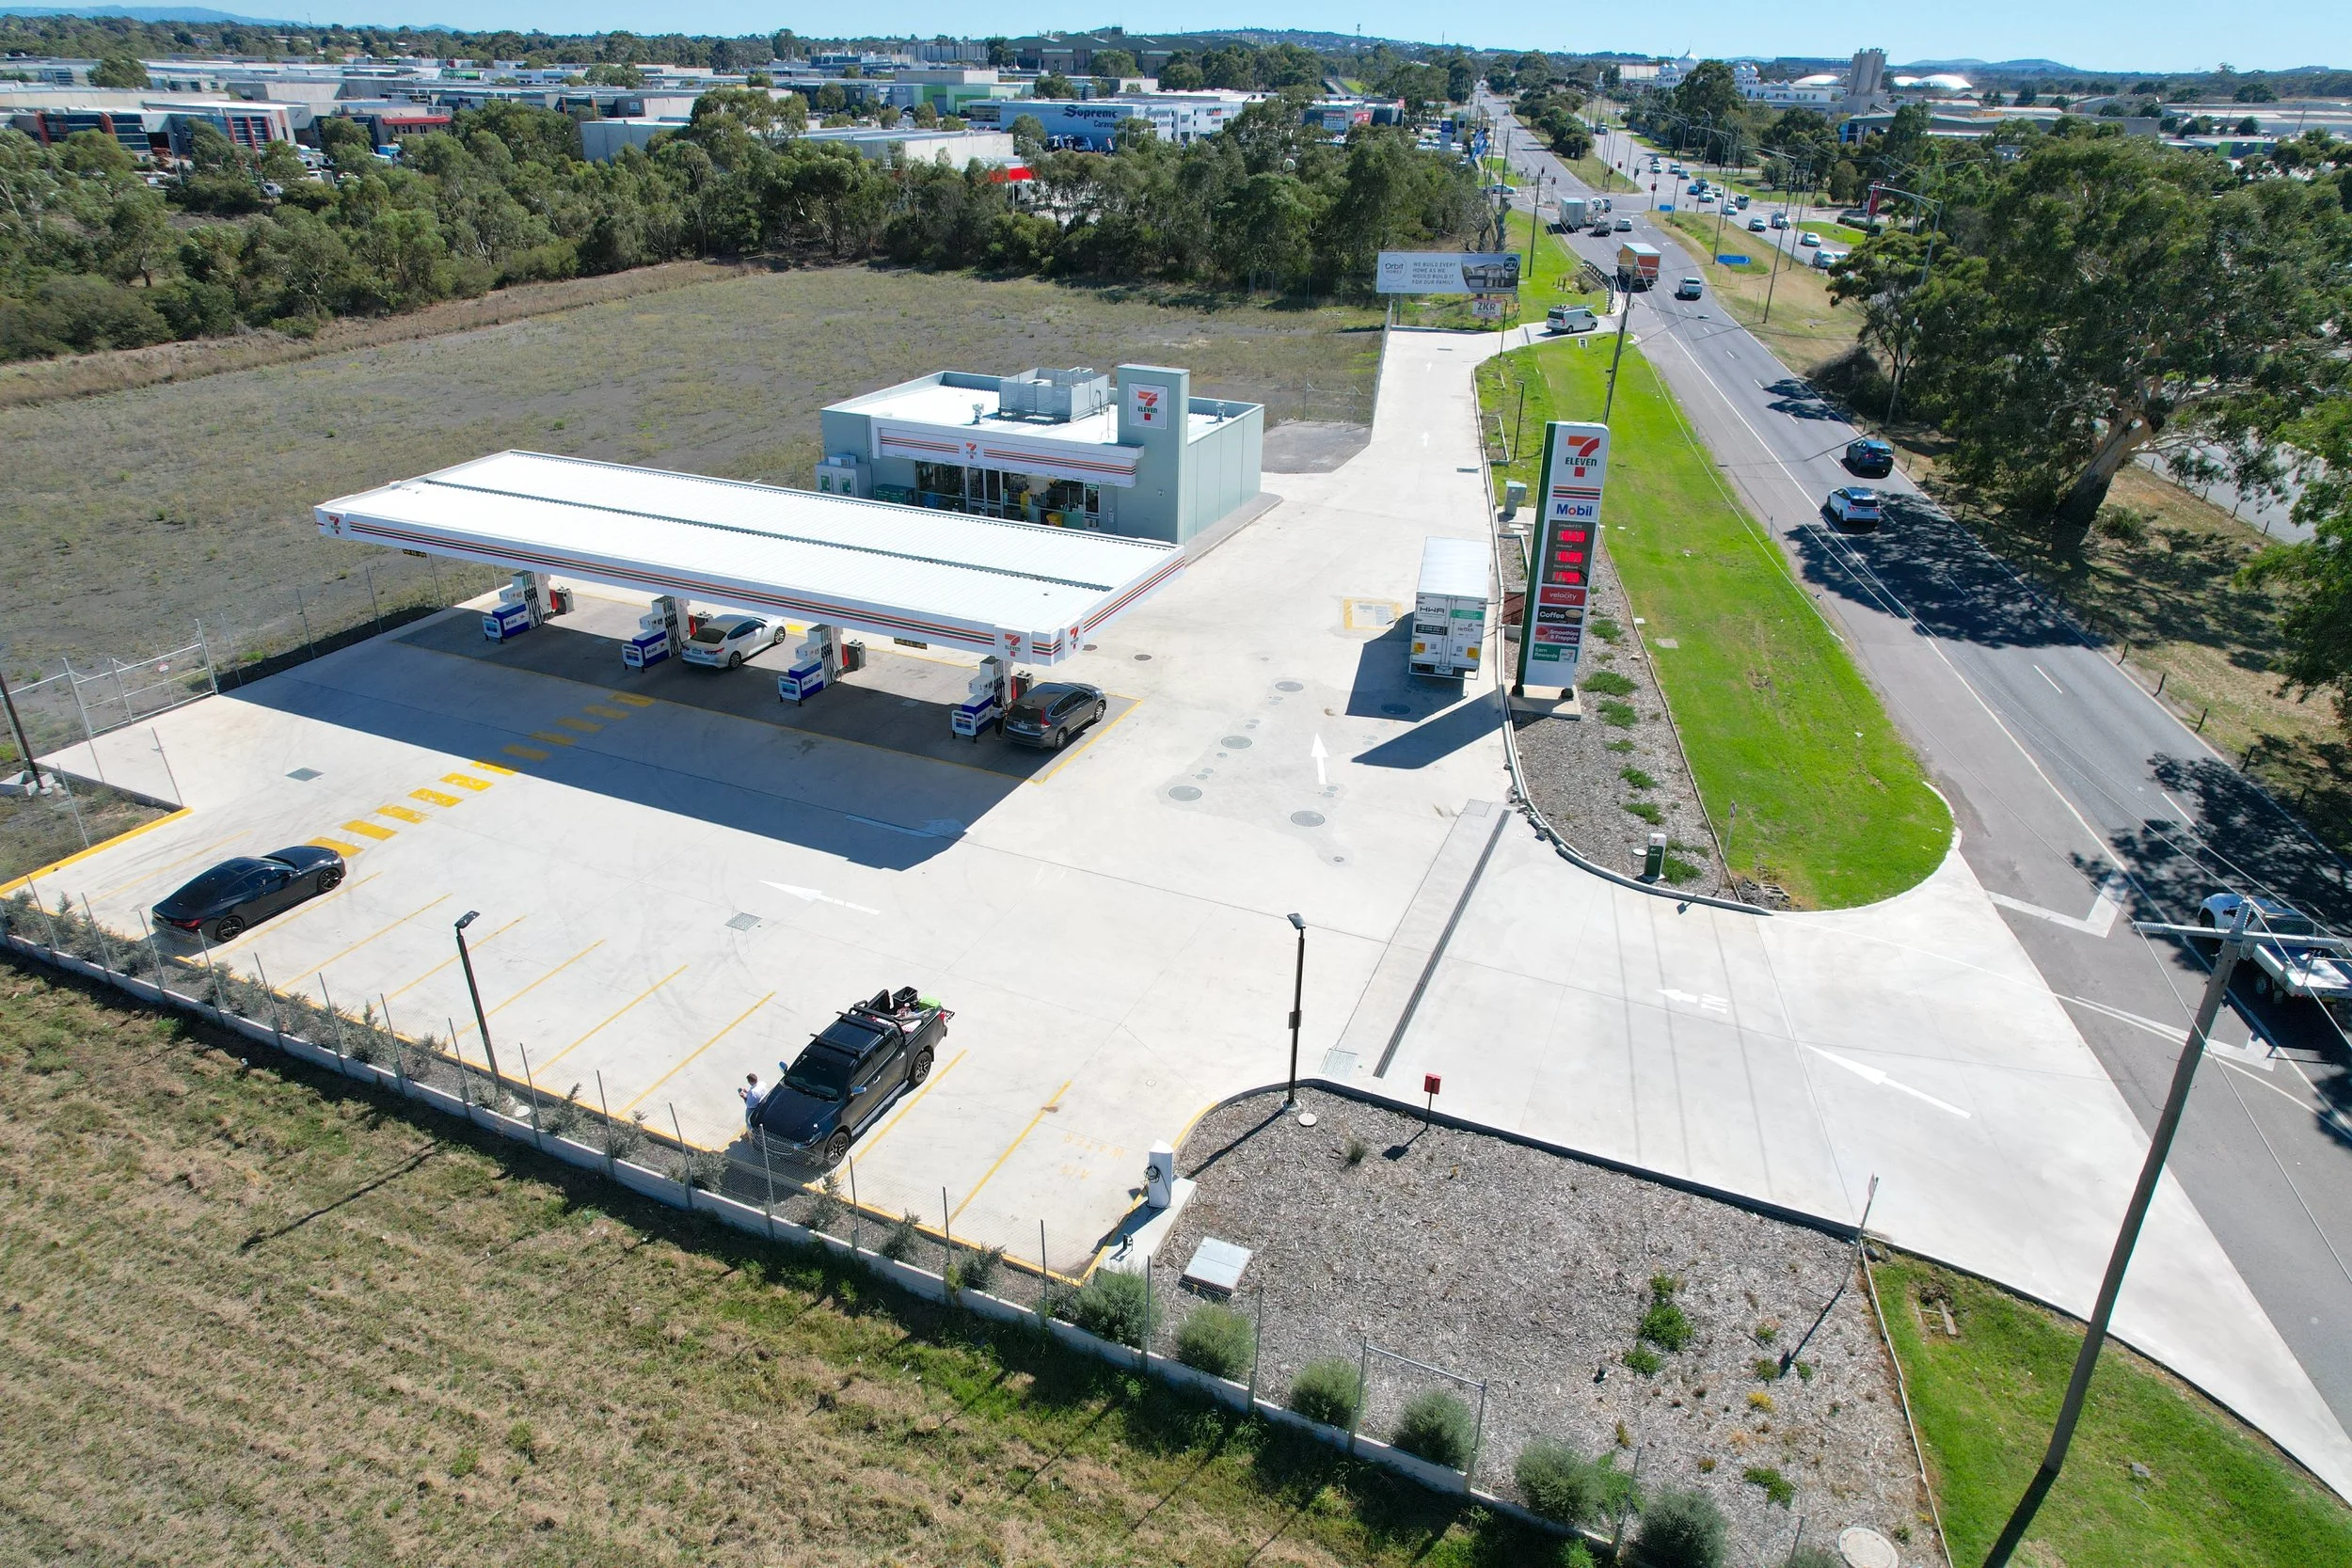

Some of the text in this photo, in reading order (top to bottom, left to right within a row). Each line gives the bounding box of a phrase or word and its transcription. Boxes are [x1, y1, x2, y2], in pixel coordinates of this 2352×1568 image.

[1477, 302, 1496, 311] ZKR
[1567, 436, 1600, 477] 7
[1556, 503, 1593, 516] Mobil
[1549, 592, 1577, 600] velocity
